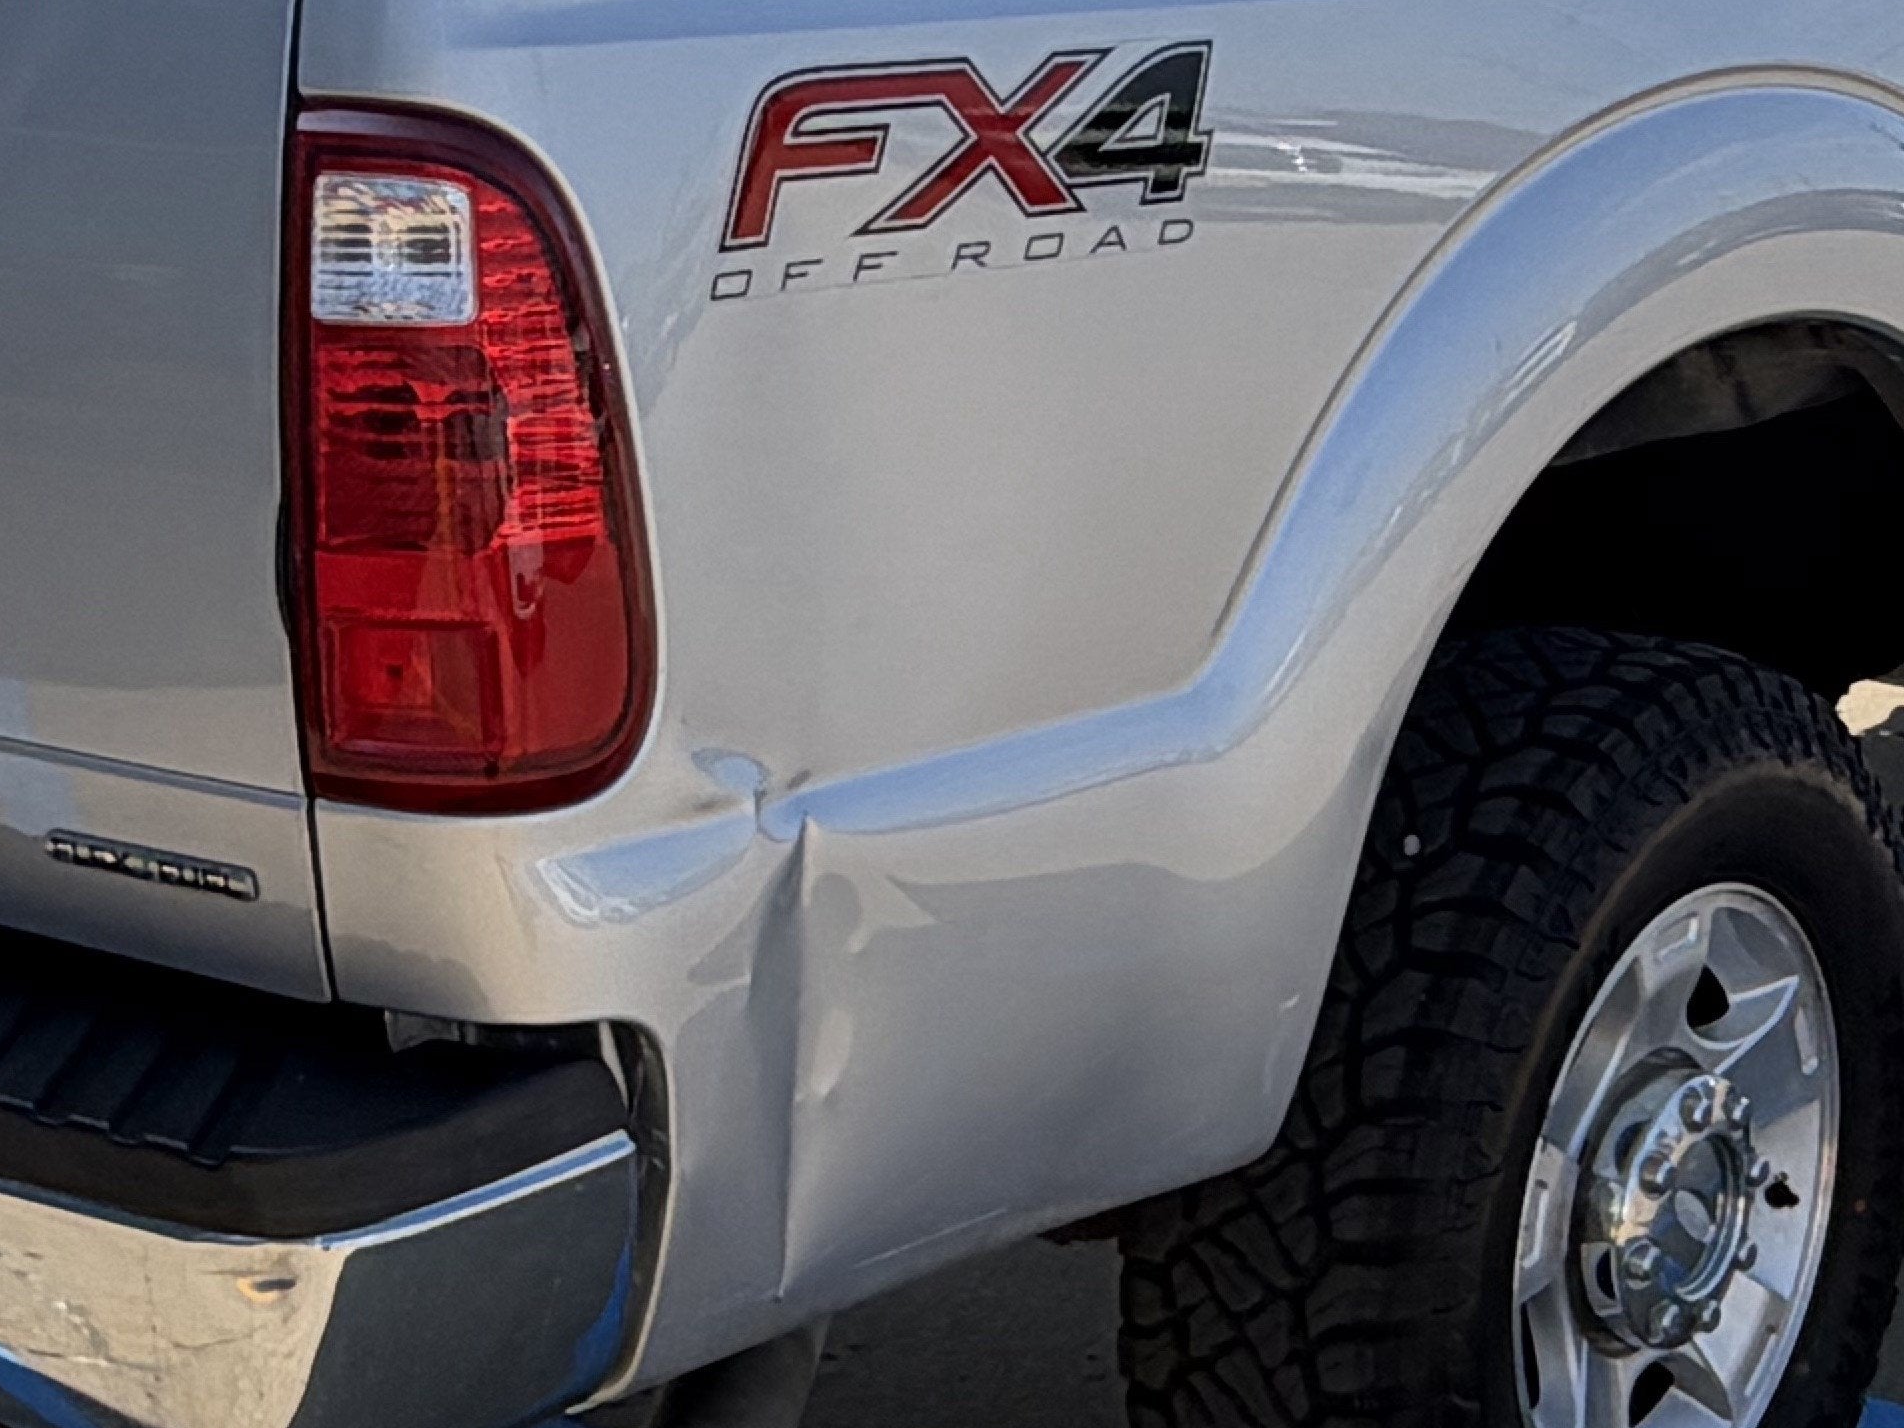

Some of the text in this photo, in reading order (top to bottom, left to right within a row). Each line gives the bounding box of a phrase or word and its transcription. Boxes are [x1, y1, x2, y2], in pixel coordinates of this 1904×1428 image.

[717, 38, 1214, 254] FX4
[710, 218, 1195, 302] OFF ROAD
